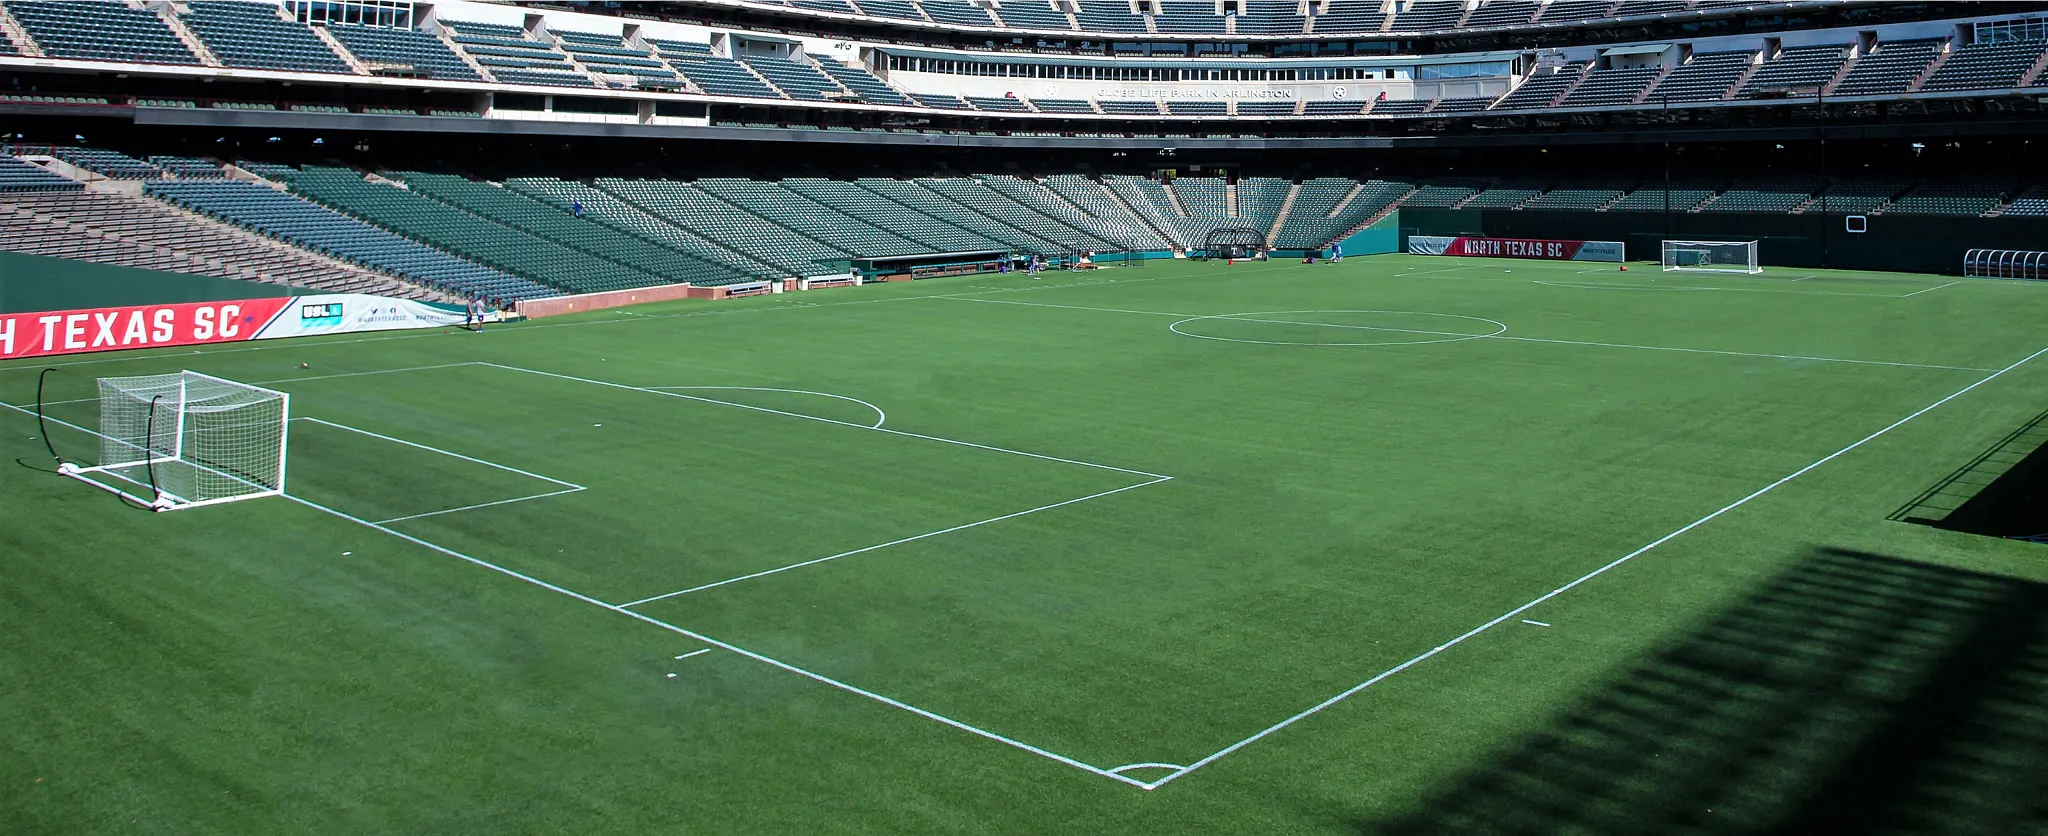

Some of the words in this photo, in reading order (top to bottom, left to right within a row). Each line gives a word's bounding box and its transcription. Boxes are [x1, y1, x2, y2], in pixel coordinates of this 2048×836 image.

[1098, 88, 1135, 97] GLOBE
[1140, 89, 1167, 97] LIFE
[1171, 89, 1202, 97] PARK
[1207, 89, 1219, 97] IN
[1223, 89, 1292, 98] ARLINGTON
[1464, 240, 1500, 255] NORTH
[1505, 241, 1543, 256] TEXAS
[1547, 242, 1563, 257] SC
[39, 308, 175, 351] TEXAS
[193, 304, 241, 340] SC
